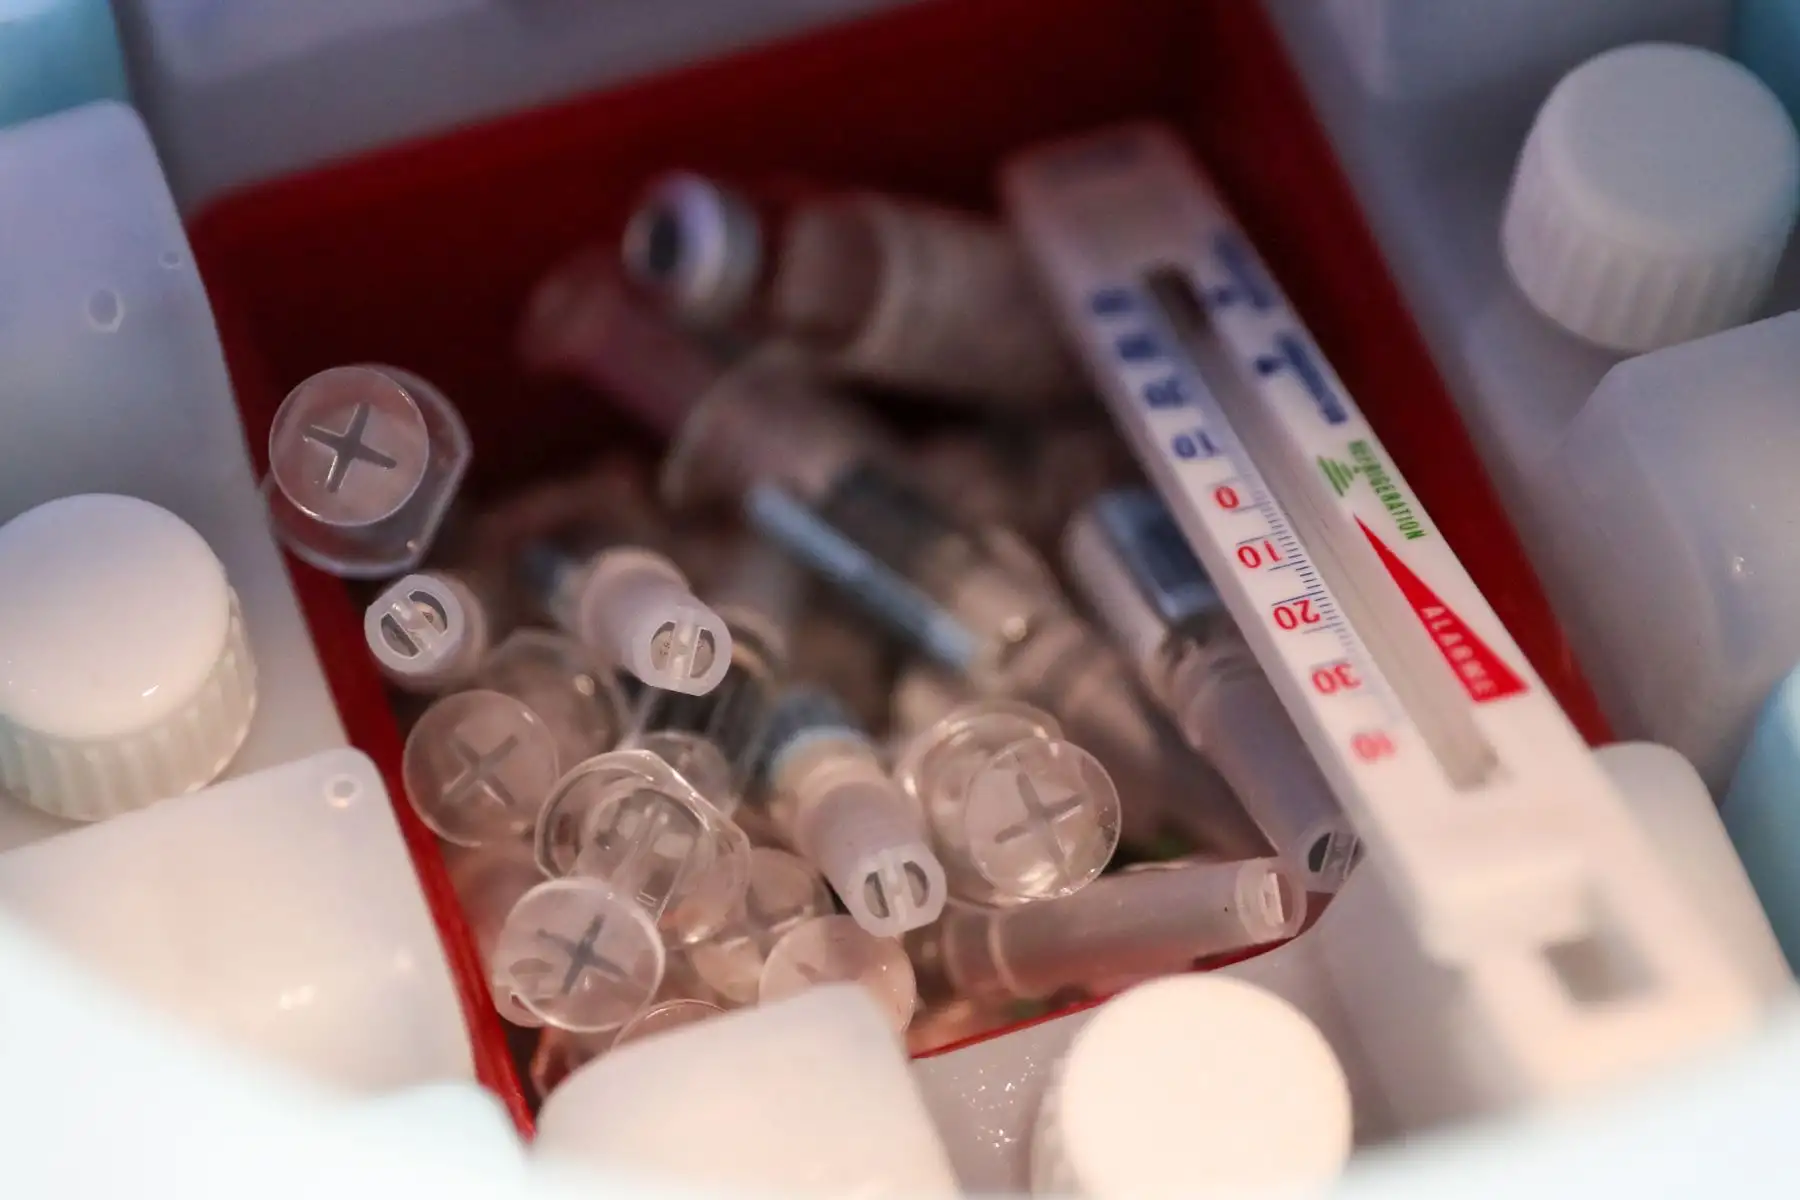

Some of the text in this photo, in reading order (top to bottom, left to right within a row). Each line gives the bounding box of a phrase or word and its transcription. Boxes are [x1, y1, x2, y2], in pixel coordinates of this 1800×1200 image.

[1172, 429, 1217, 458] 10
[1214, 486, 1239, 509] 0
[1236, 540, 1282, 569] 10
[1272, 600, 1320, 630] 20
[1311, 663, 1361, 694] 30
